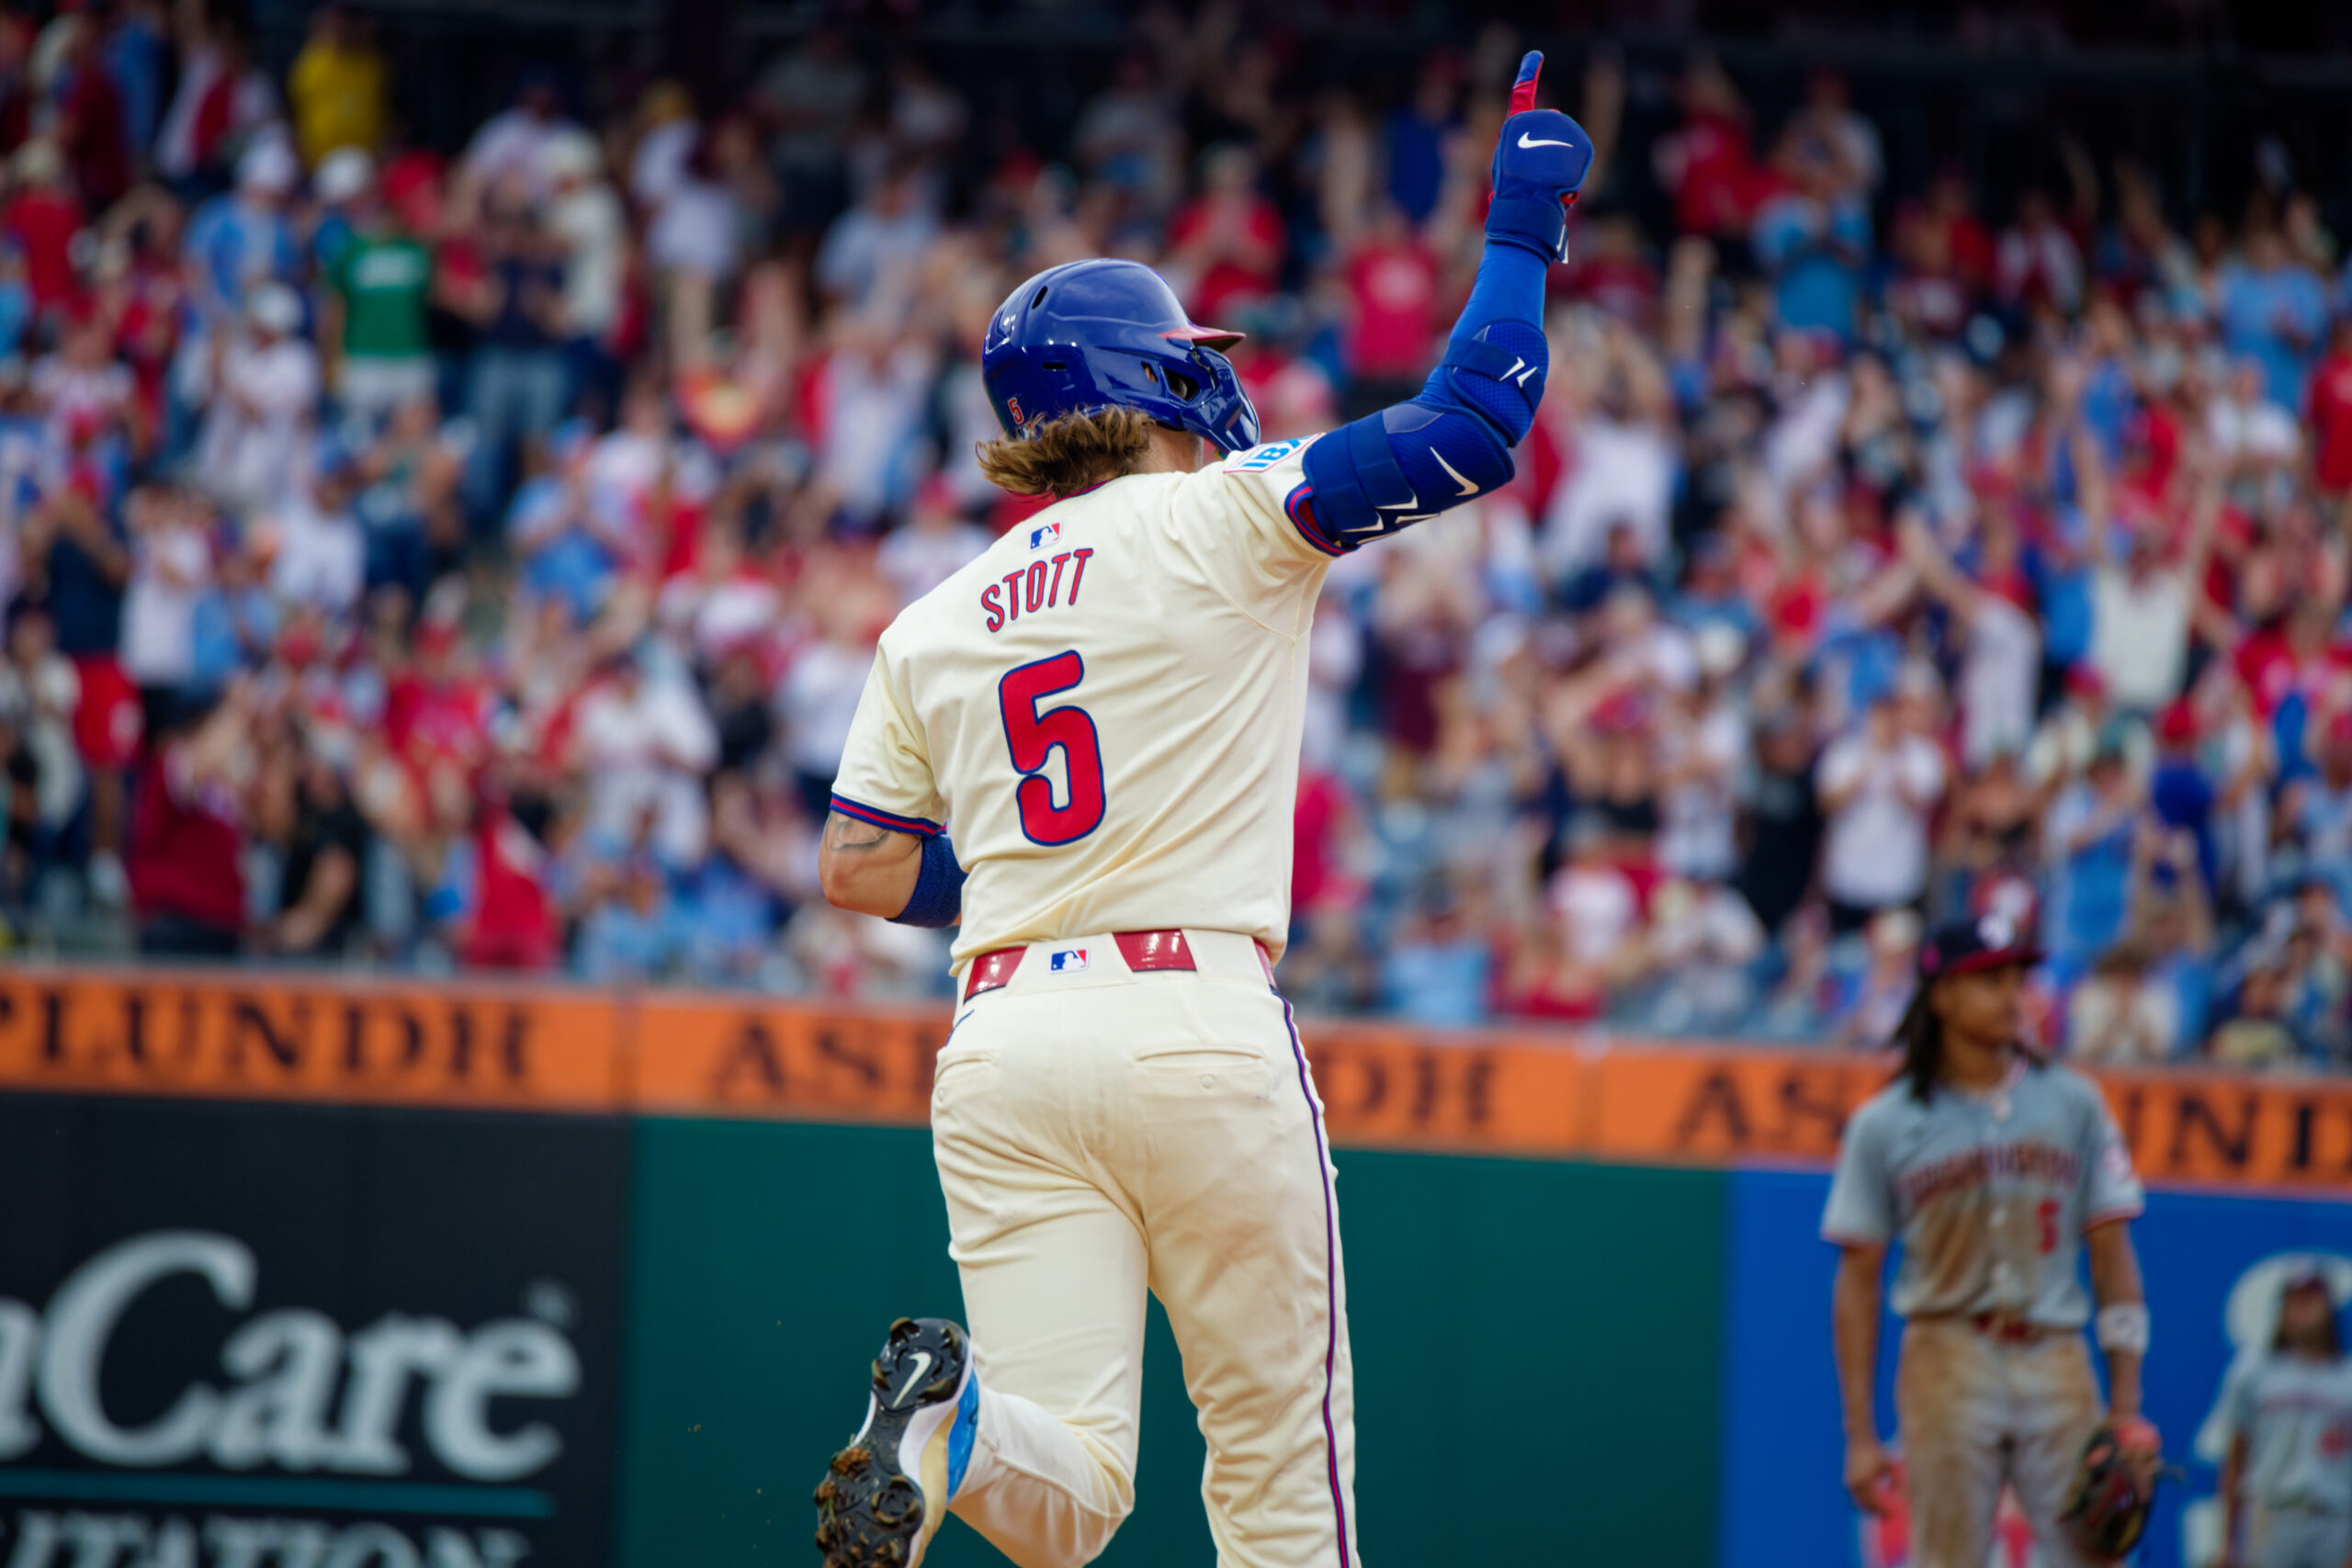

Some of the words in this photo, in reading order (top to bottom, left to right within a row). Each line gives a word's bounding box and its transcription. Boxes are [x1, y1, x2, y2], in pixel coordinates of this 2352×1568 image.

[1007, 397, 1024, 424] 5
[980, 547, 1094, 632] STOTT
[998, 649, 1106, 847] 5
